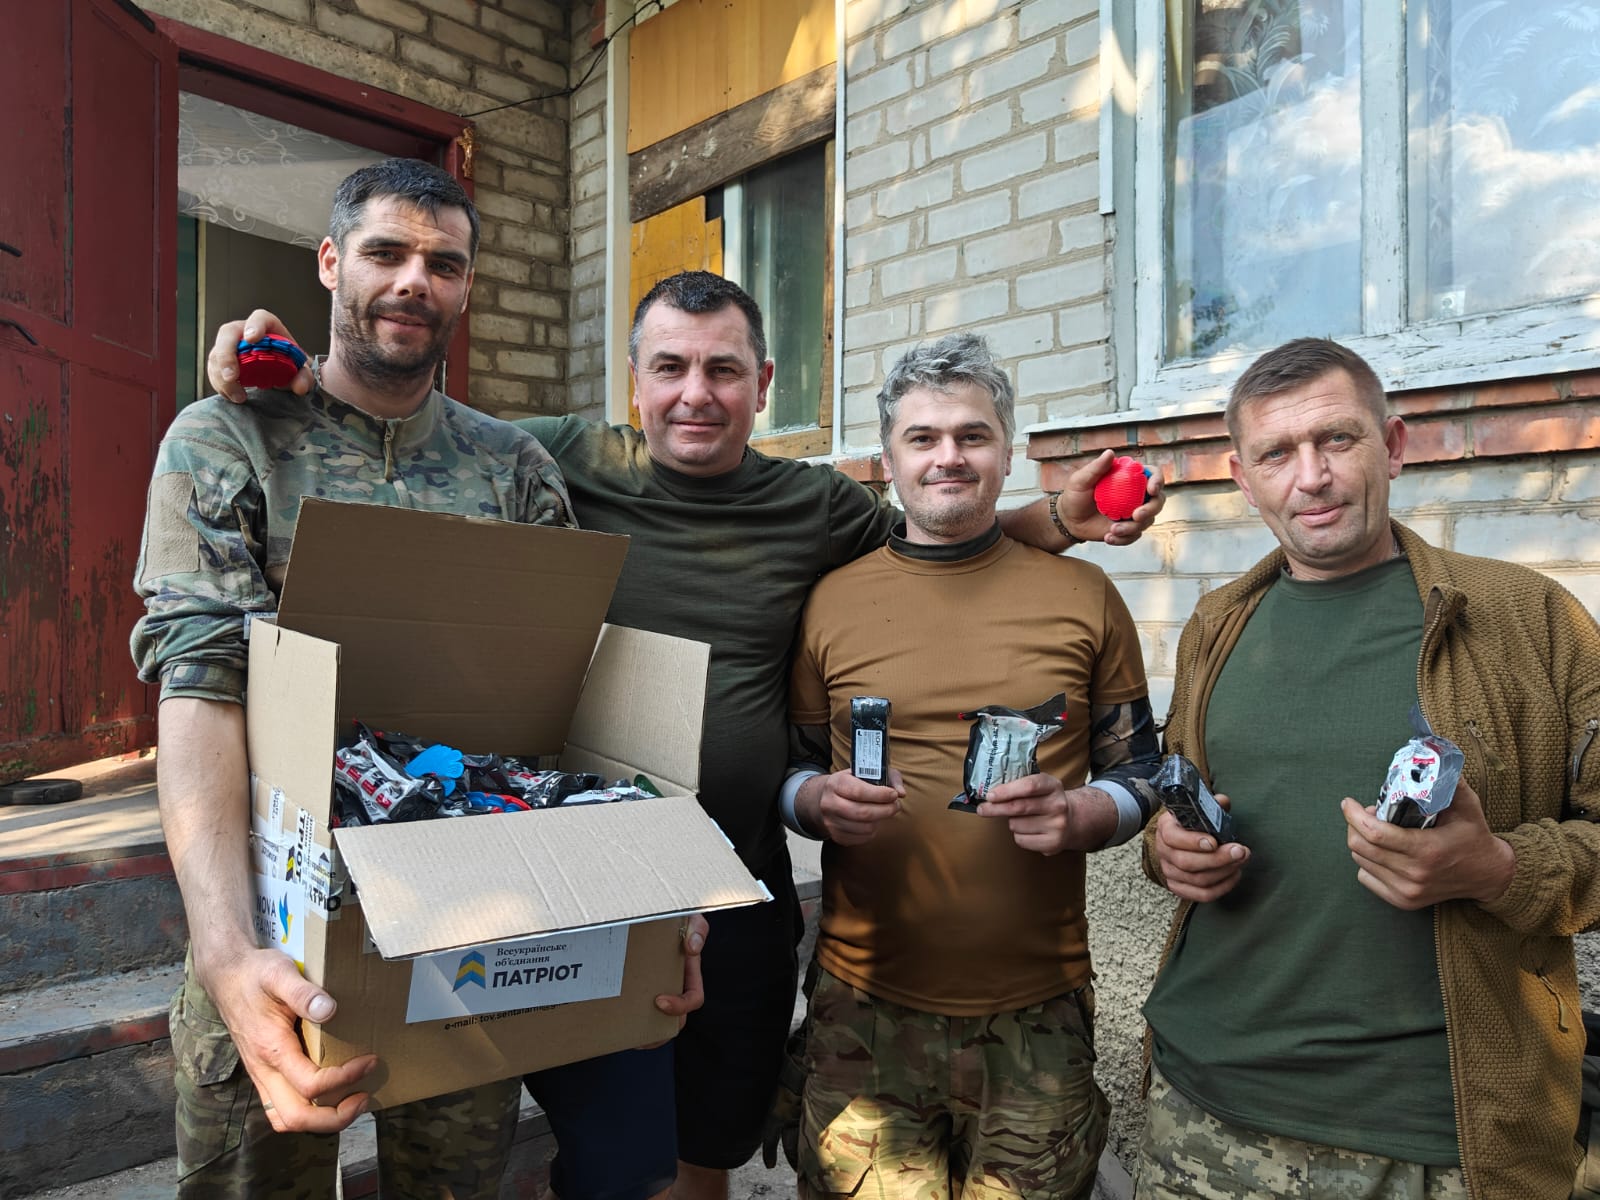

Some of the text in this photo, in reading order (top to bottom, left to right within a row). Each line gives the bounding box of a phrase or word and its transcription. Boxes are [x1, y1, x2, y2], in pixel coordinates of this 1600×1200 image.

[256, 895, 277, 918] NOVA
[496, 943, 568, 957] Всеукраїнське
[492, 963, 583, 988] ПАТРІОТ
[444, 1016, 477, 1030] e-mail:
